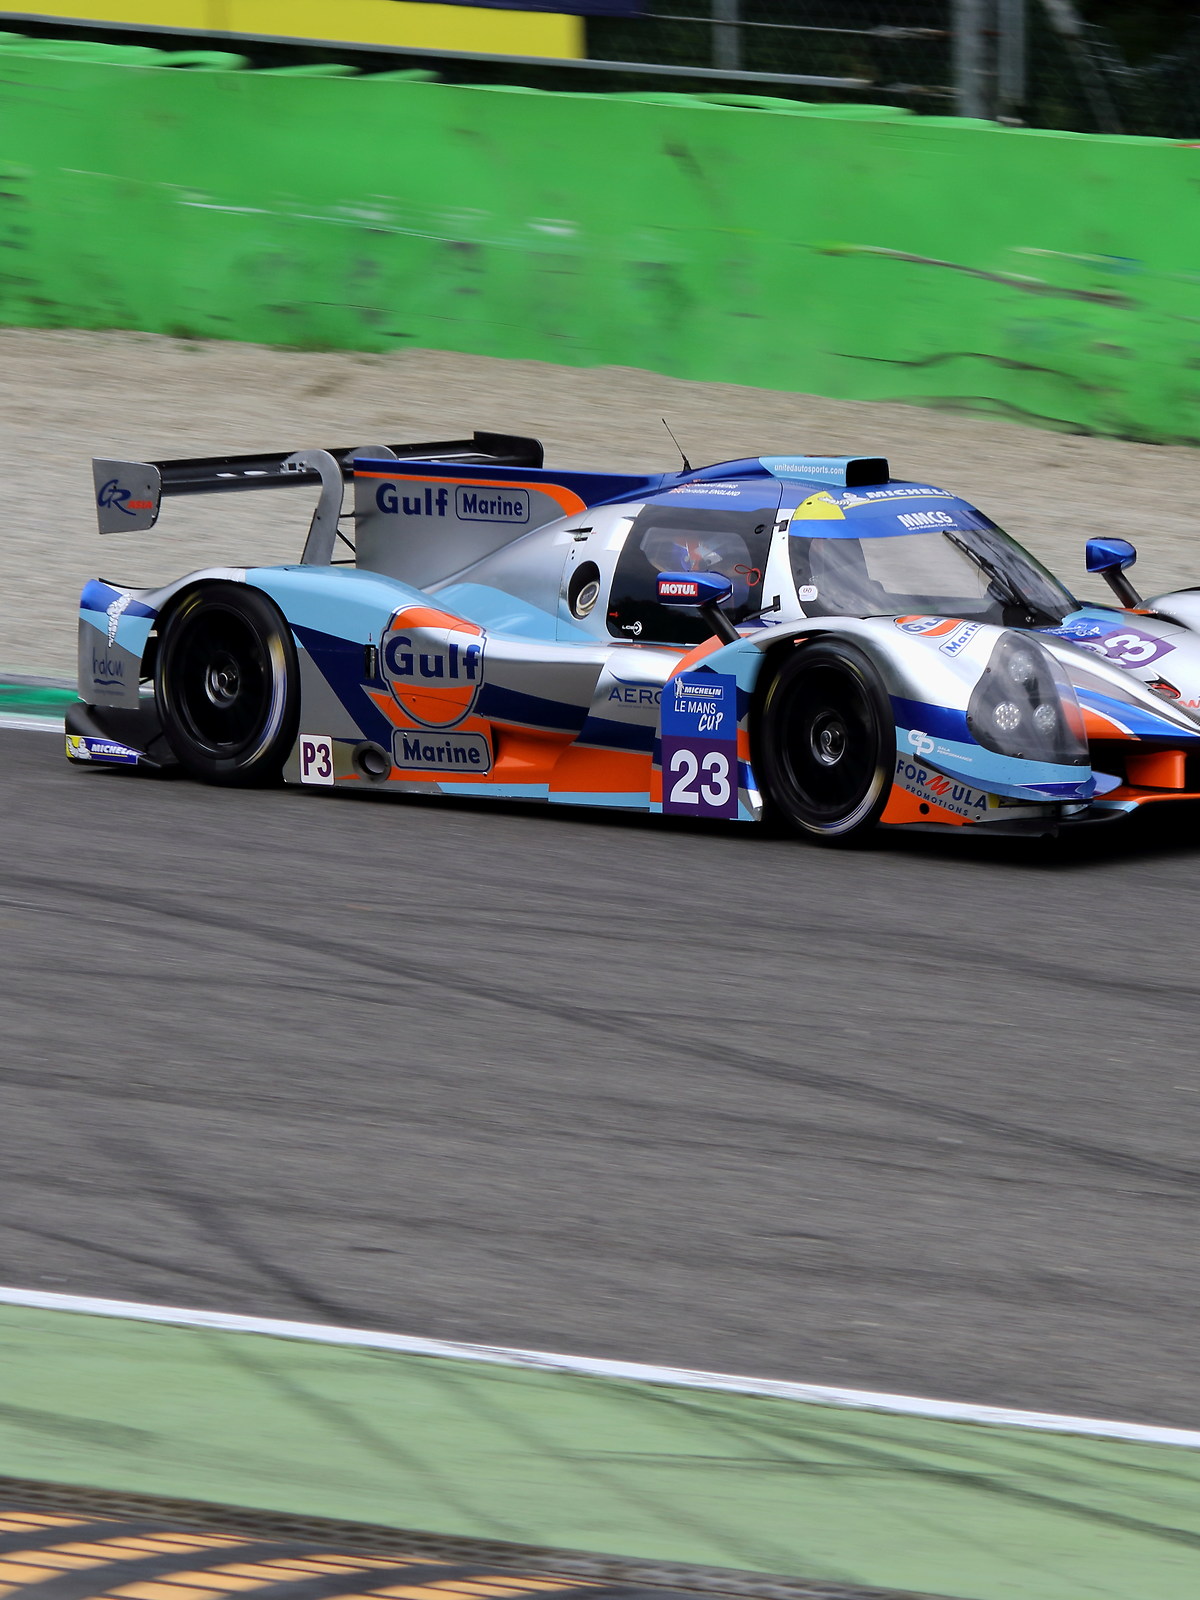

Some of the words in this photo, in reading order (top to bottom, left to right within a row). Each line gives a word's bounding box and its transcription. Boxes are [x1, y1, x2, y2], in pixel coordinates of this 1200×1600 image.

[774, 463, 844, 475] unitedautosports.com
[127, 500, 153, 509] ASIA
[375, 482, 448, 516] Gulf
[462, 493, 523, 516] Marine
[896, 511, 954, 528] MMCG
[660, 583, 696, 595] MOTUL
[385, 636, 481, 680] Gulf
[684, 686, 722, 696] MICHELIN
[674, 700, 686, 712] LE
[688, 701, 716, 714] MANS
[698, 712, 724, 731] CUP
[302, 742, 332, 778] P3
[403, 738, 481, 764] Marine
[669, 749, 731, 807] 23
[896, 759, 988, 811] FORMULA
[905, 784, 969, 817] PROMOTIONS
